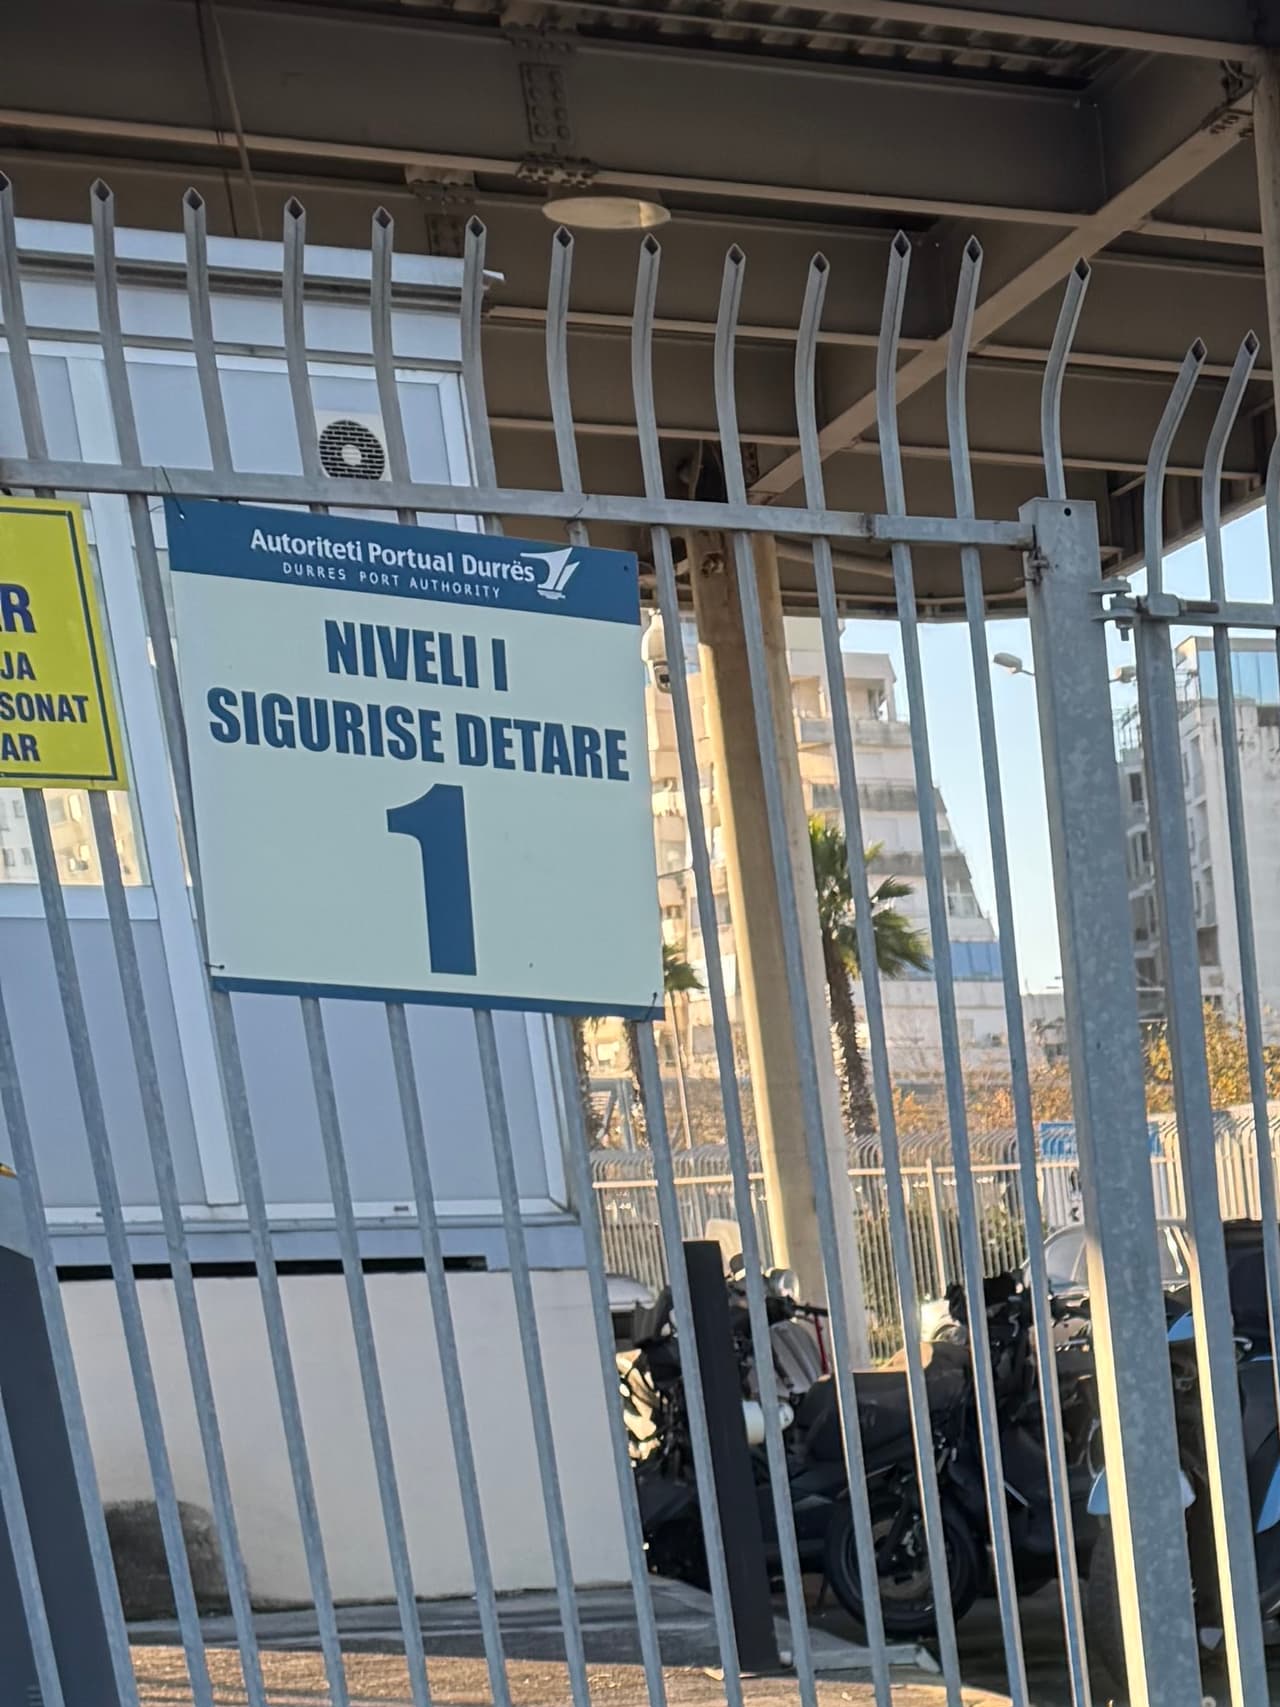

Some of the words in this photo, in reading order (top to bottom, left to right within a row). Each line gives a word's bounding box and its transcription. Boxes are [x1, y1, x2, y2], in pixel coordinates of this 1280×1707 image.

[251, 529, 362, 563] Autoriteti
[368, 542, 454, 573] Portual
[462, 554, 536, 583] Durrës
[283, 562, 346, 581] DURRES
[359, 571, 400, 588] PORT
[409, 579, 501, 599] AUTHORITY
[0, 583, 37, 633] R
[324, 619, 478, 690] NIVELI
[491, 638, 508, 692] I
[2, 733, 40, 762] AR
[207, 687, 444, 763] SIGURISE
[456, 713, 630, 782] DETARE
[386, 783, 477, 976] 1
